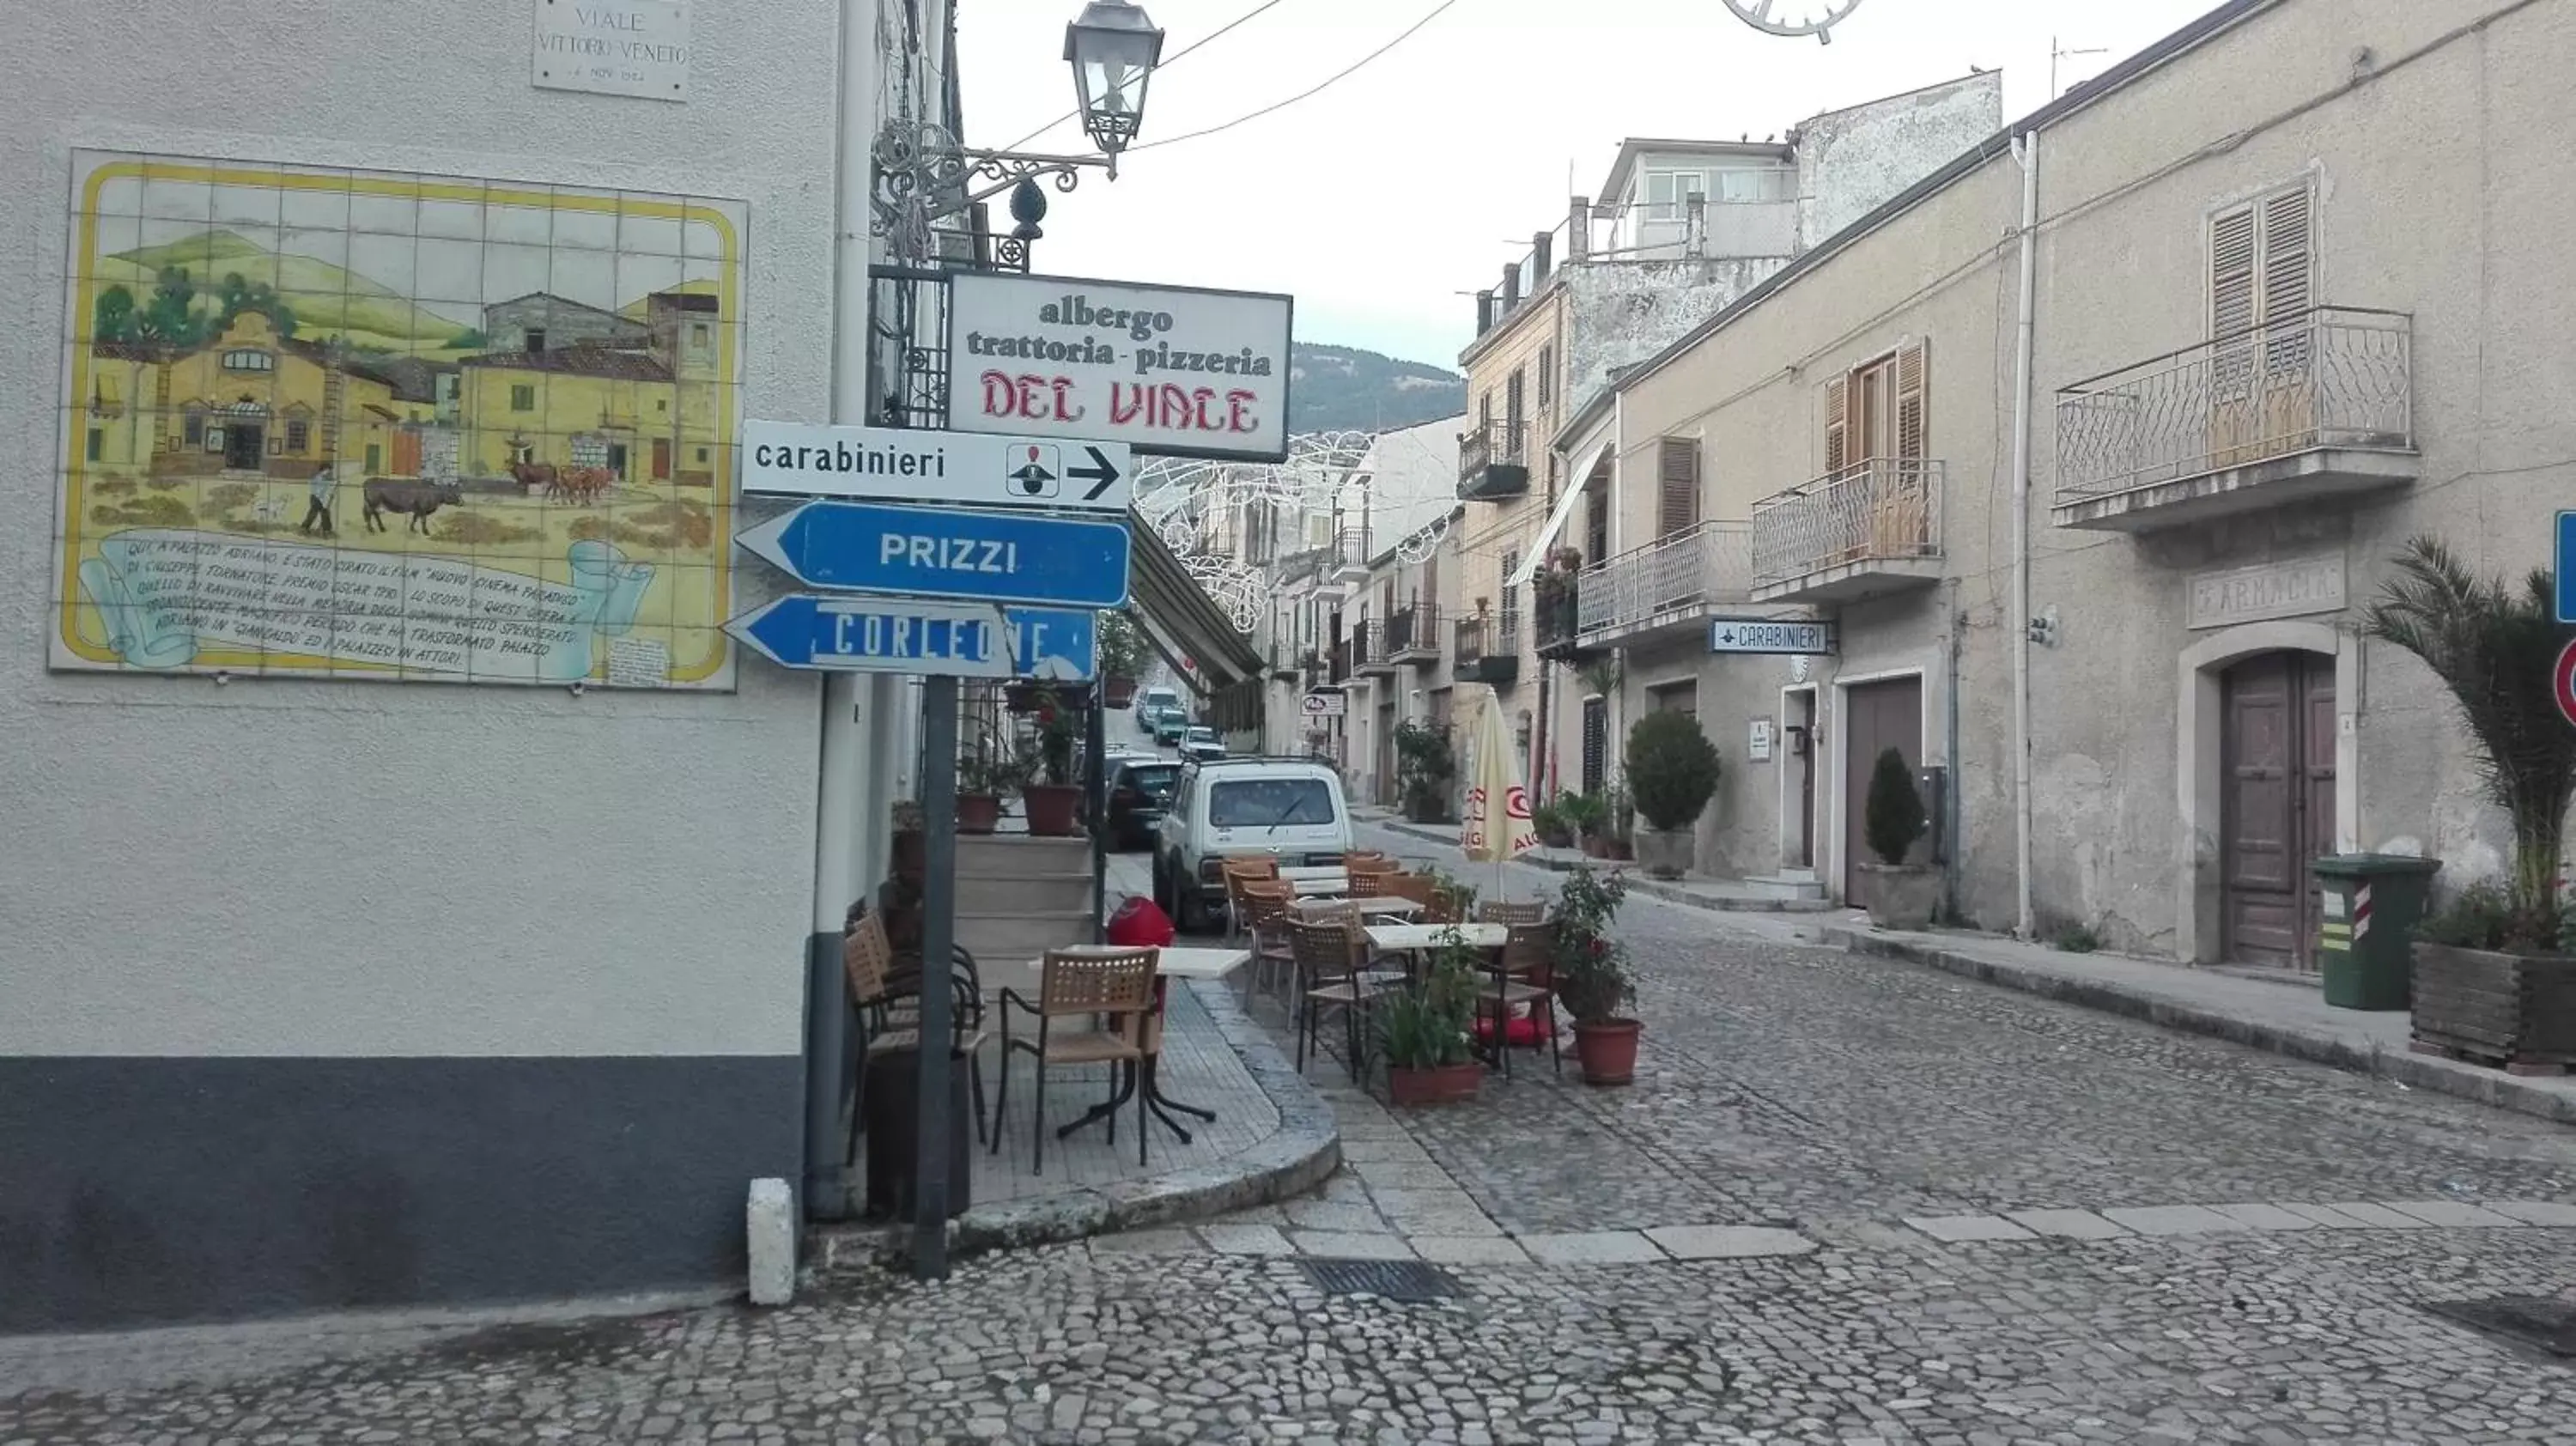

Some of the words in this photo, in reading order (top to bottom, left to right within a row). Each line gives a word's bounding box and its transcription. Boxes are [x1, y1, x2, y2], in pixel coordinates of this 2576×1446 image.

[576, 7, 647, 33] VIALE
[538, 33, 613, 57] VITTORIO
[618, 41, 687, 66] VENETO
[1039, 295, 1173, 342] albergo
[967, 331, 1114, 364] trattoria
[1135, 341, 1272, 376] pizzeria
[980, 369, 1085, 422] DEL
[1109, 381, 1260, 434] VIALE
[755, 439, 945, 477] carabinieri
[171, 541, 221, 556] PALAZZO
[293, 556, 331, 570] STATO
[474, 577, 519, 592] CINEMA
[879, 532, 1018, 574] PRIZZI
[137, 580, 183, 595] QUELLO
[145, 560, 201, 575] GIUSEPPE
[283, 576, 328, 592] PREMIO
[427, 591, 466, 606] SCOPO
[410, 627, 495, 650] TRASFORMATO
[499, 640, 550, 657] PALAZZO
[1739, 625, 1820, 649] CARABINIERI
